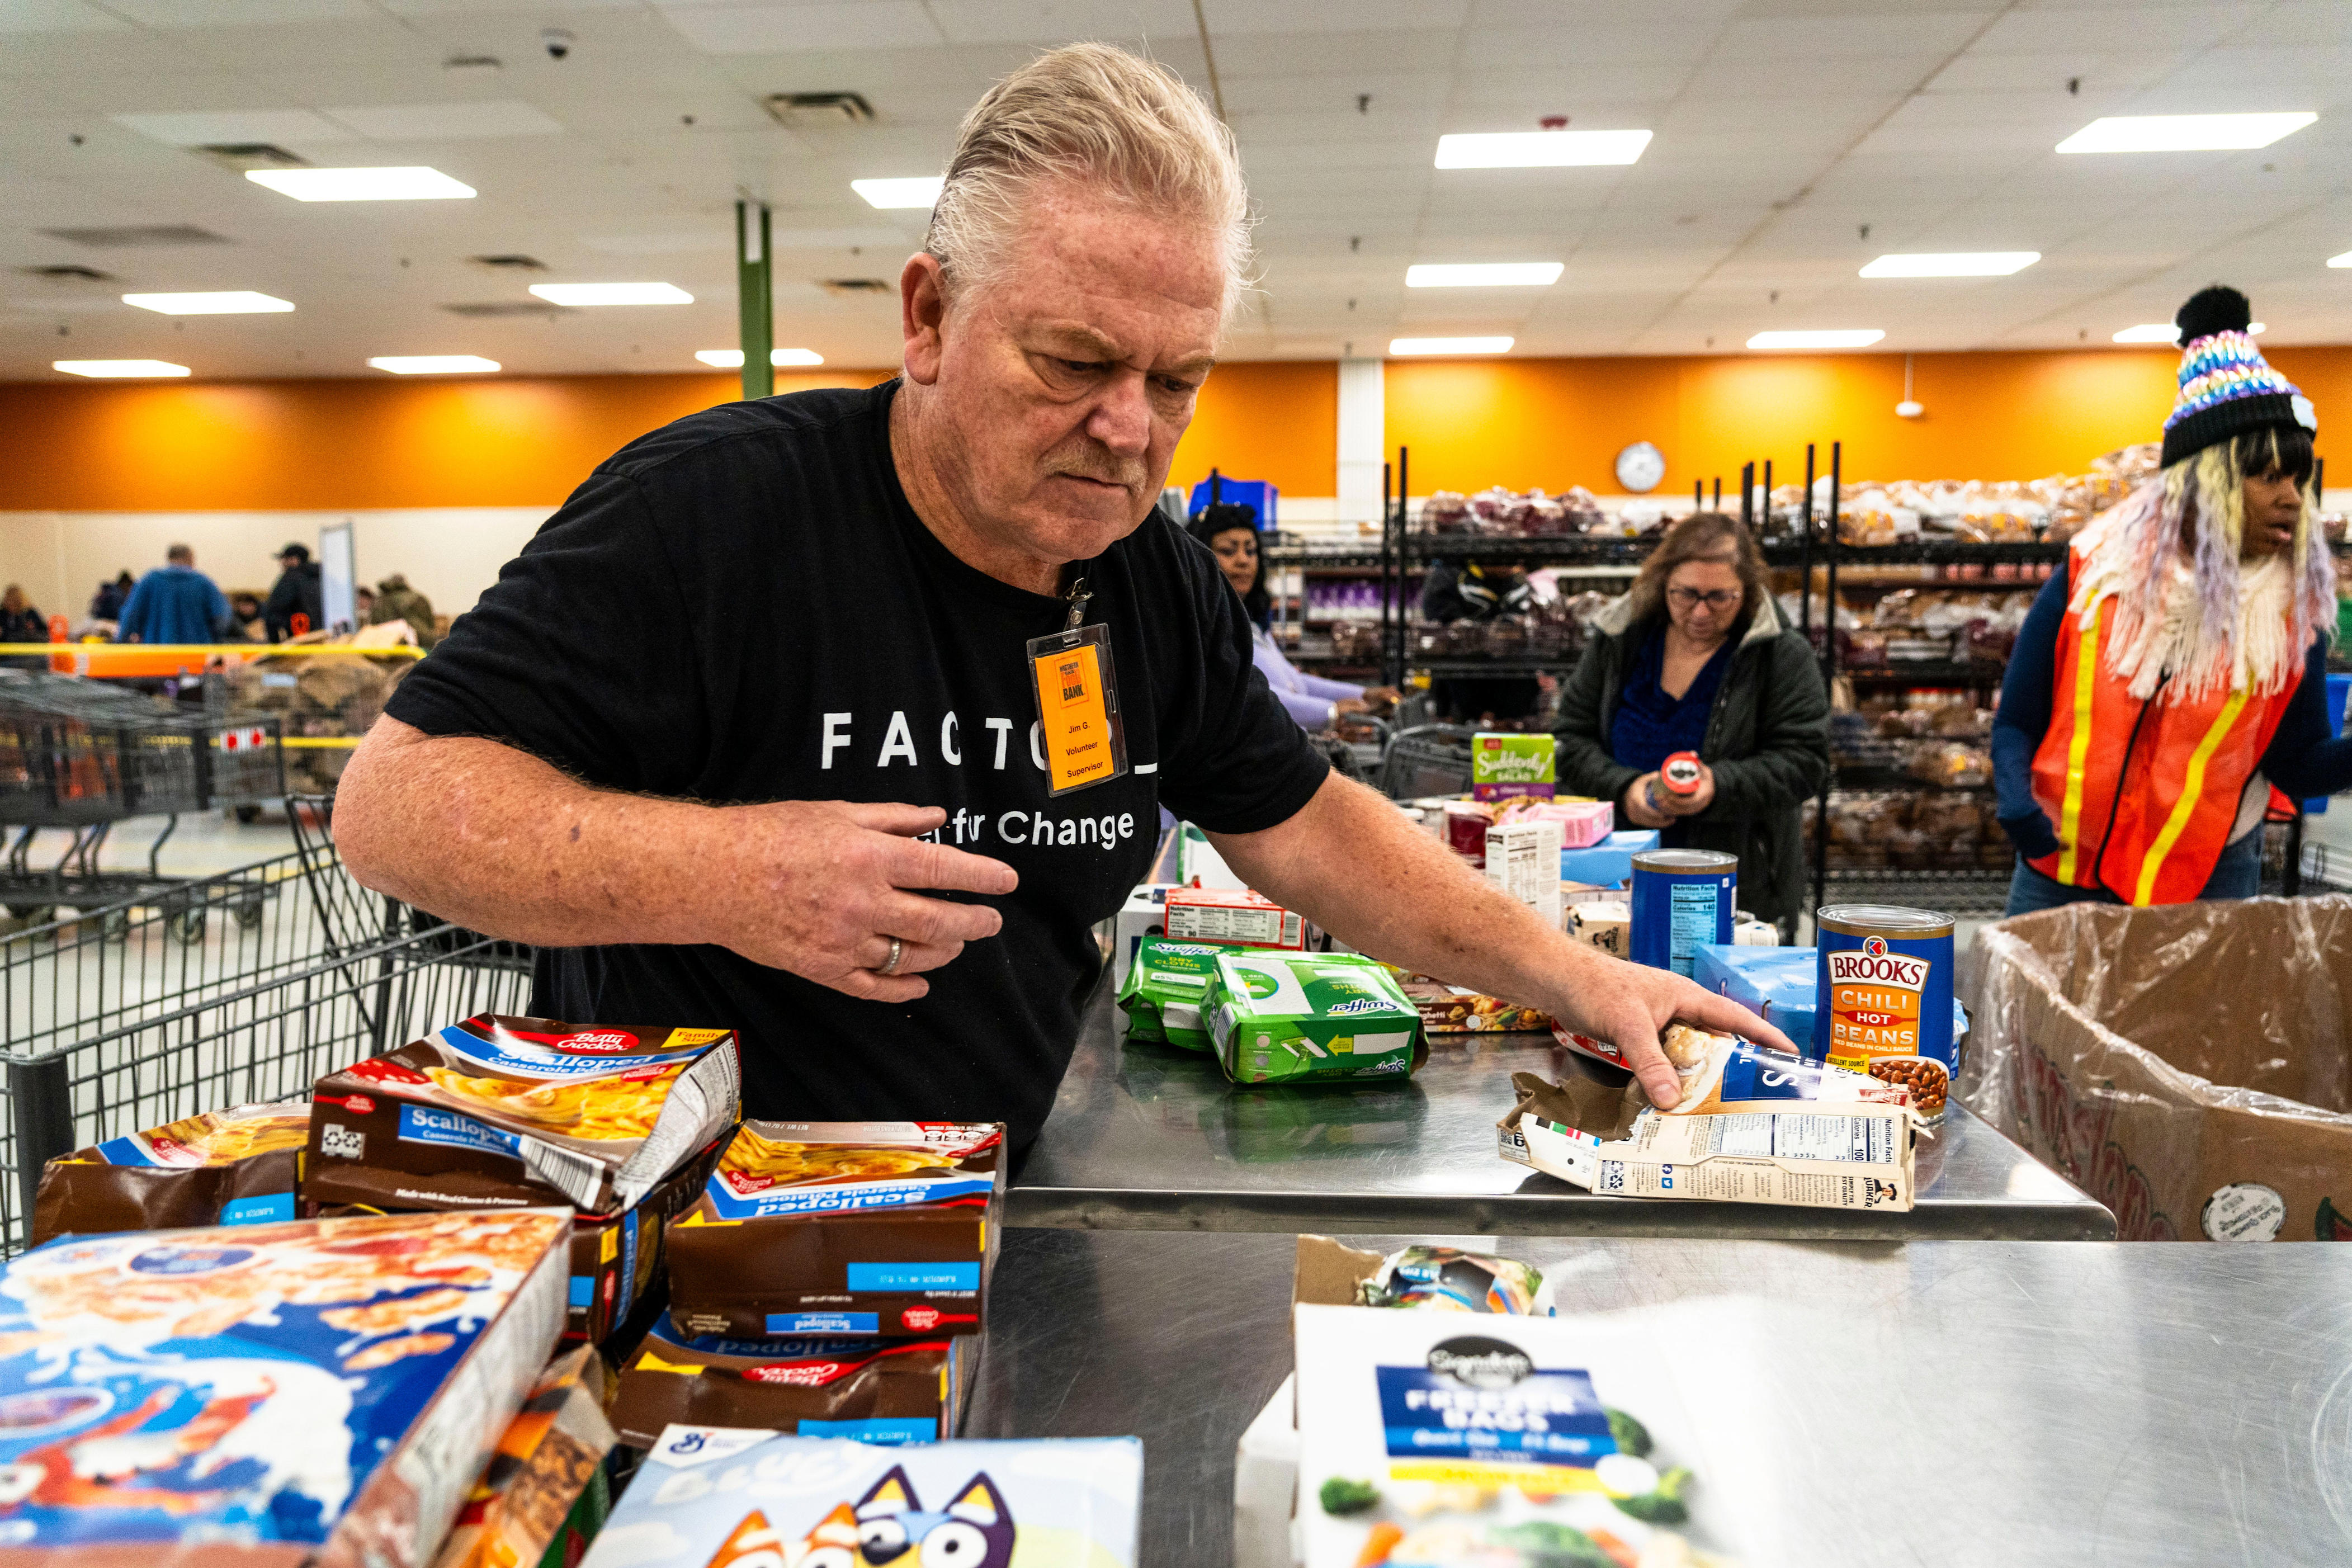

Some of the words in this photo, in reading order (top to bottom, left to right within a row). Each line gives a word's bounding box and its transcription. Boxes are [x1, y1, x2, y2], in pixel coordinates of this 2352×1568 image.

[1063, 684, 1084, 701] BANK
[1069, 724, 1081, 734] Jim
[1083, 721, 1090, 730] G.
[1066, 742, 1098, 756] Volunteer
[1067, 761, 1103, 778] Supervisor
[998, 810, 1134, 851] Change
[1149, 943, 1220, 955] Swiffer
[1154, 959, 1201, 969] CLOTHS
[1833, 957, 1923, 985] BROOKS
[1328, 998, 1399, 1013] Swiffer
[1840, 990, 1907, 1010] CHILI
[1856, 1012, 1891, 1025] HOT
[573, 1032, 626, 1043] Betty
[1834, 1023, 1914, 1045] BEANS
[558, 1039, 631, 1051] Crocker
[1846, 1041, 1866, 1050] BEANS
[1355, 1059, 1405, 1074] Swiffer
[1827, 1057, 1848, 1066] EXCELLENT
[1854, 1149, 1864, 1161] 100
[758, 1192, 845, 1205] Potatoes
[849, 1185, 932, 1200] Casserole
[754, 1191, 926, 1216] Scalloped
